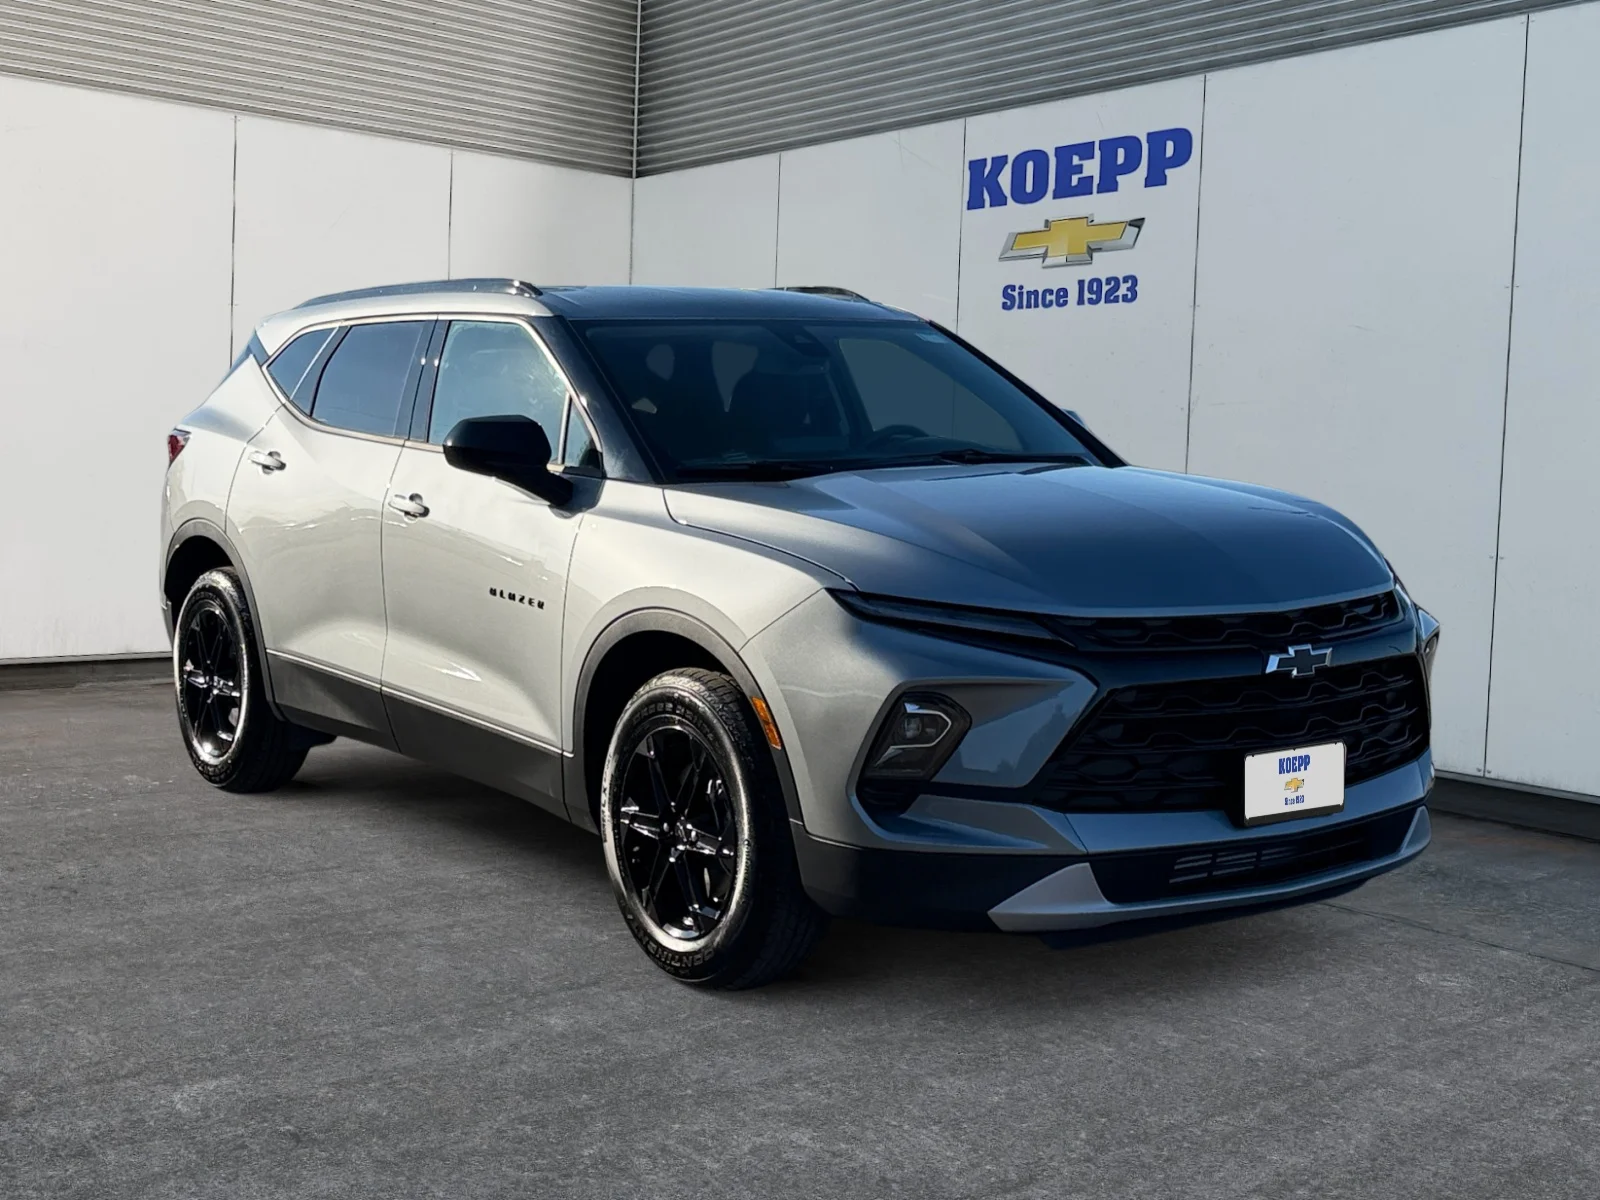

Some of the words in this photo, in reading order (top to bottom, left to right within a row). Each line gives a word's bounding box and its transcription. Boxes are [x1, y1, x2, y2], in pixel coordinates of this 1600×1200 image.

[967, 128, 1193, 210] KOEPP
[1001, 284, 1068, 311] Since
[1076, 274, 1138, 306] 1923
[489, 587, 545, 610] BLAZER
[1278, 754, 1311, 775] KOEPP
